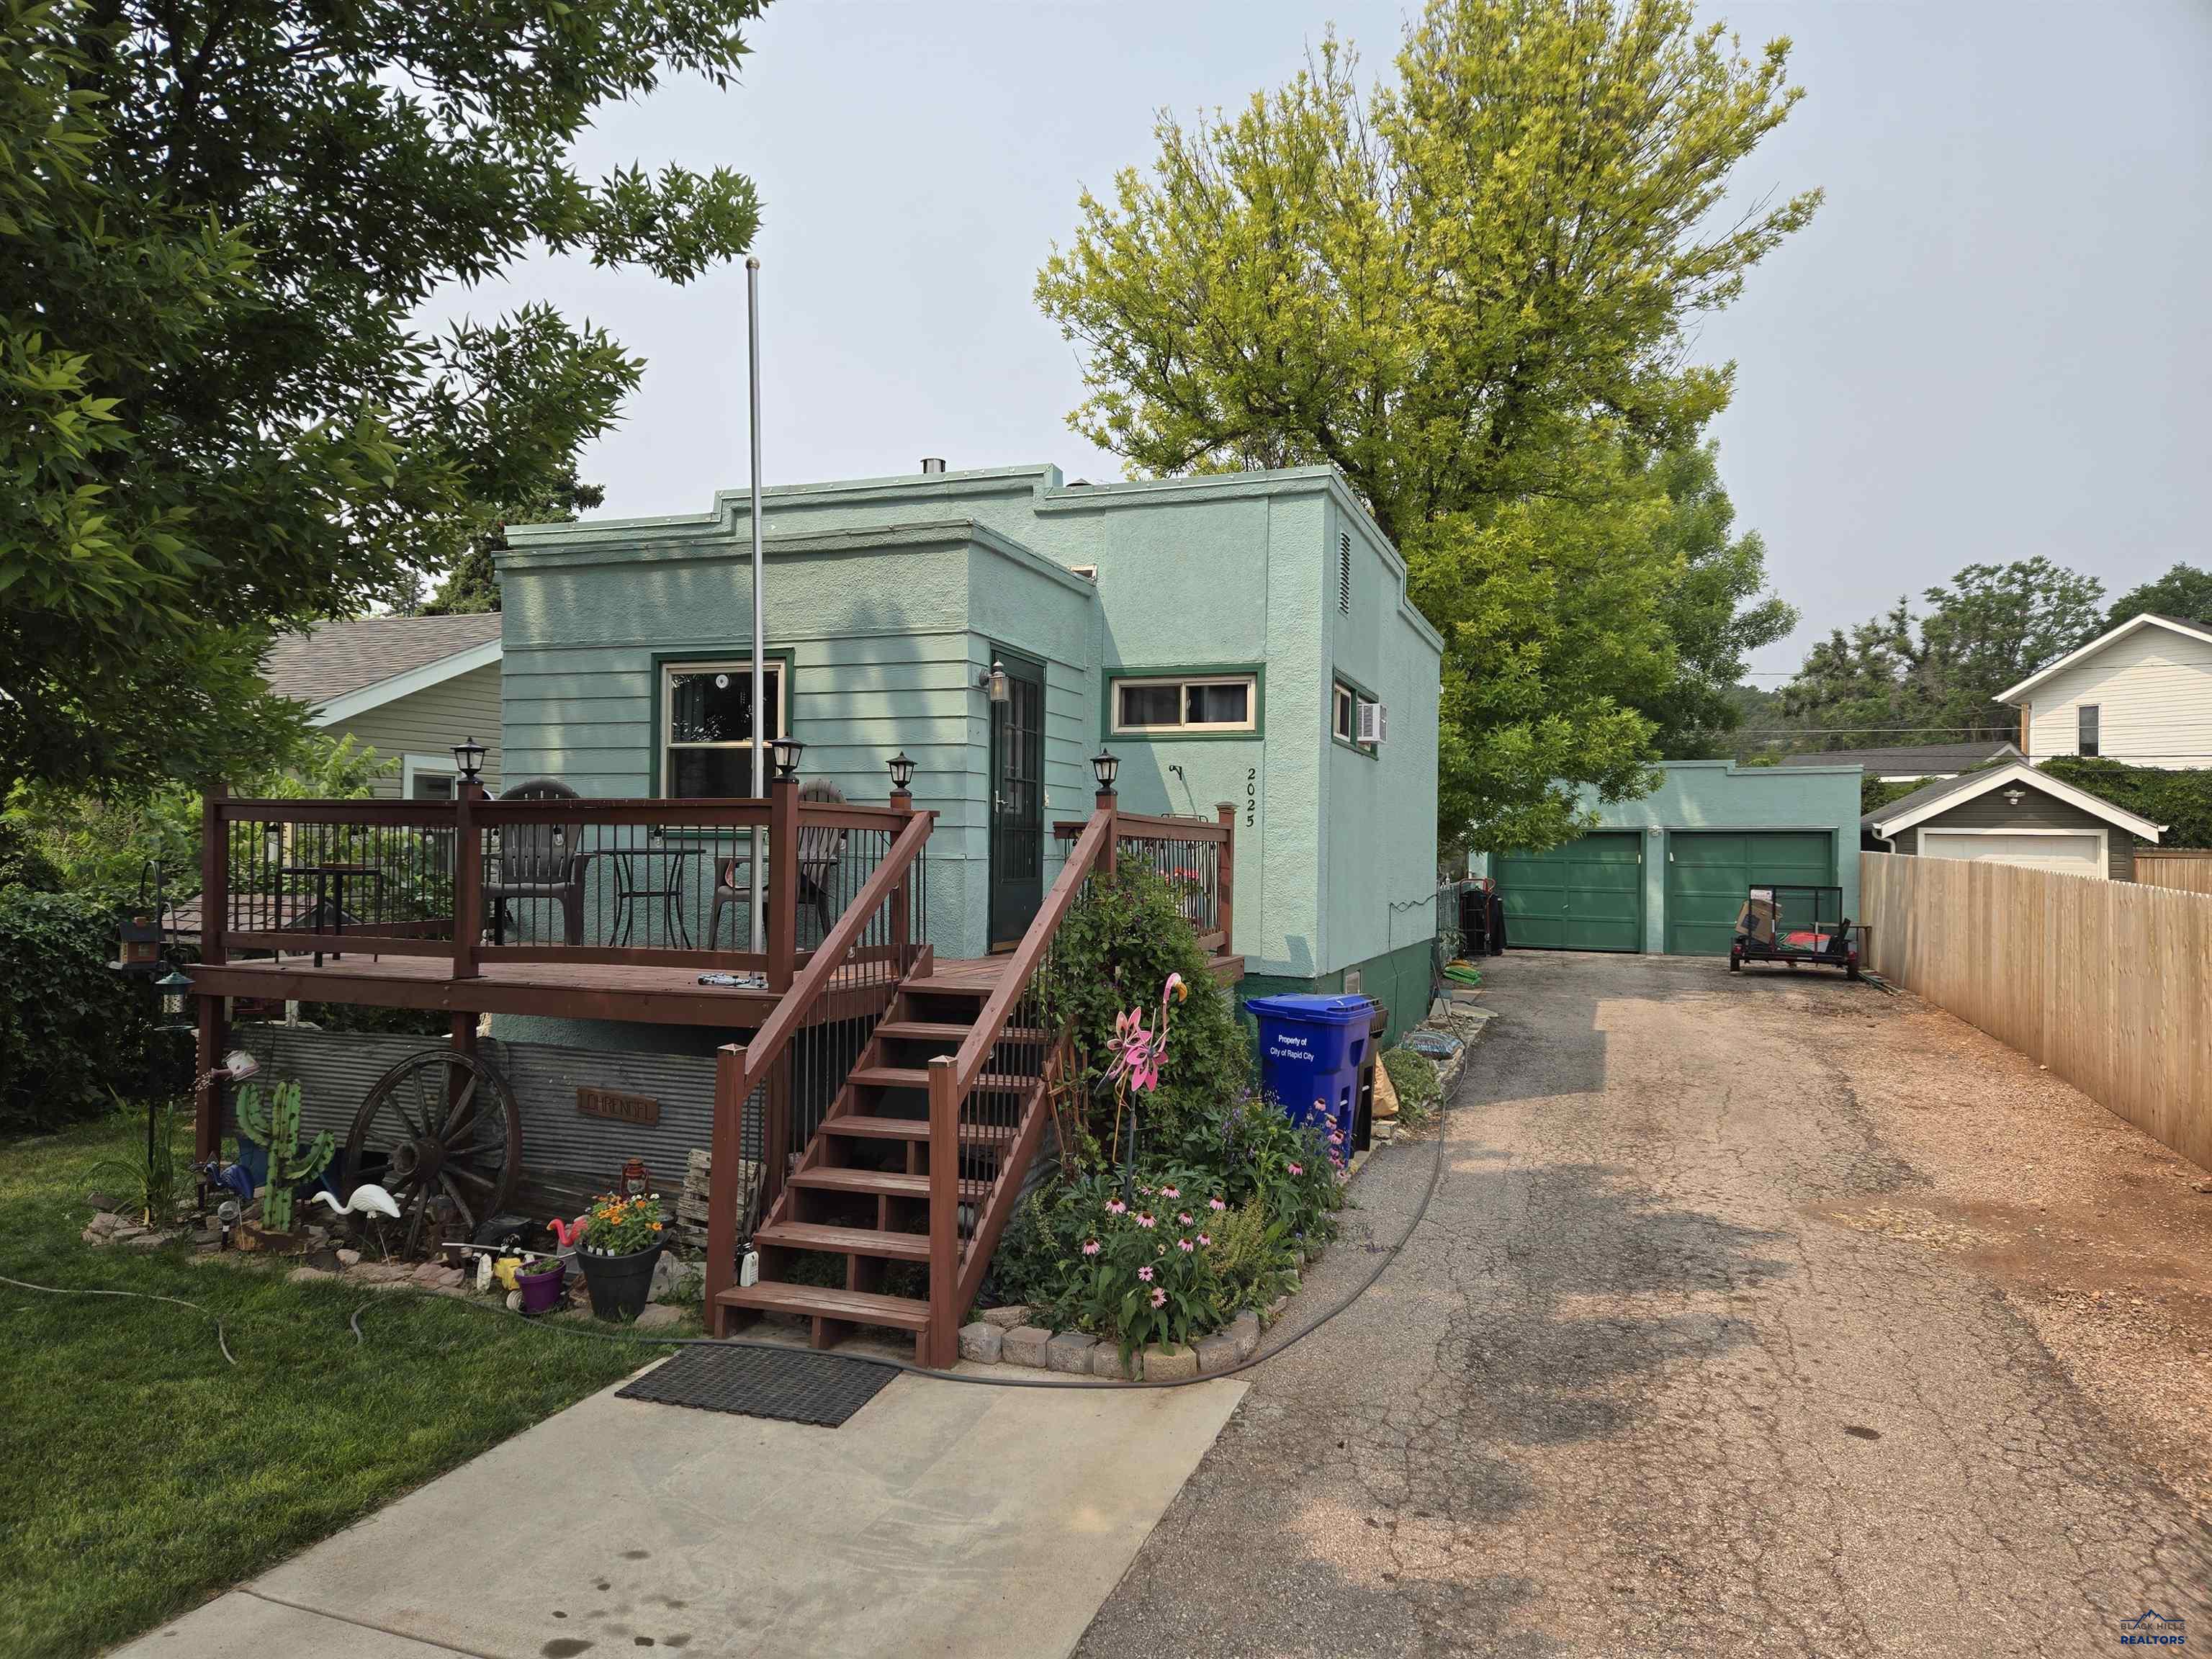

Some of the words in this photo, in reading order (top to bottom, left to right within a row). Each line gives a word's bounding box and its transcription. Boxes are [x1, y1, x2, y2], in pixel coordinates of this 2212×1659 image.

[1246, 768, 1256, 827] 2025
[1278, 1034, 1300, 1046] Property
[1300, 1038, 1308, 1046] of
[1269, 1047, 1280, 1057] City
[1287, 1049, 1303, 1059] Rapid
[1303, 1052, 1314, 1062] City
